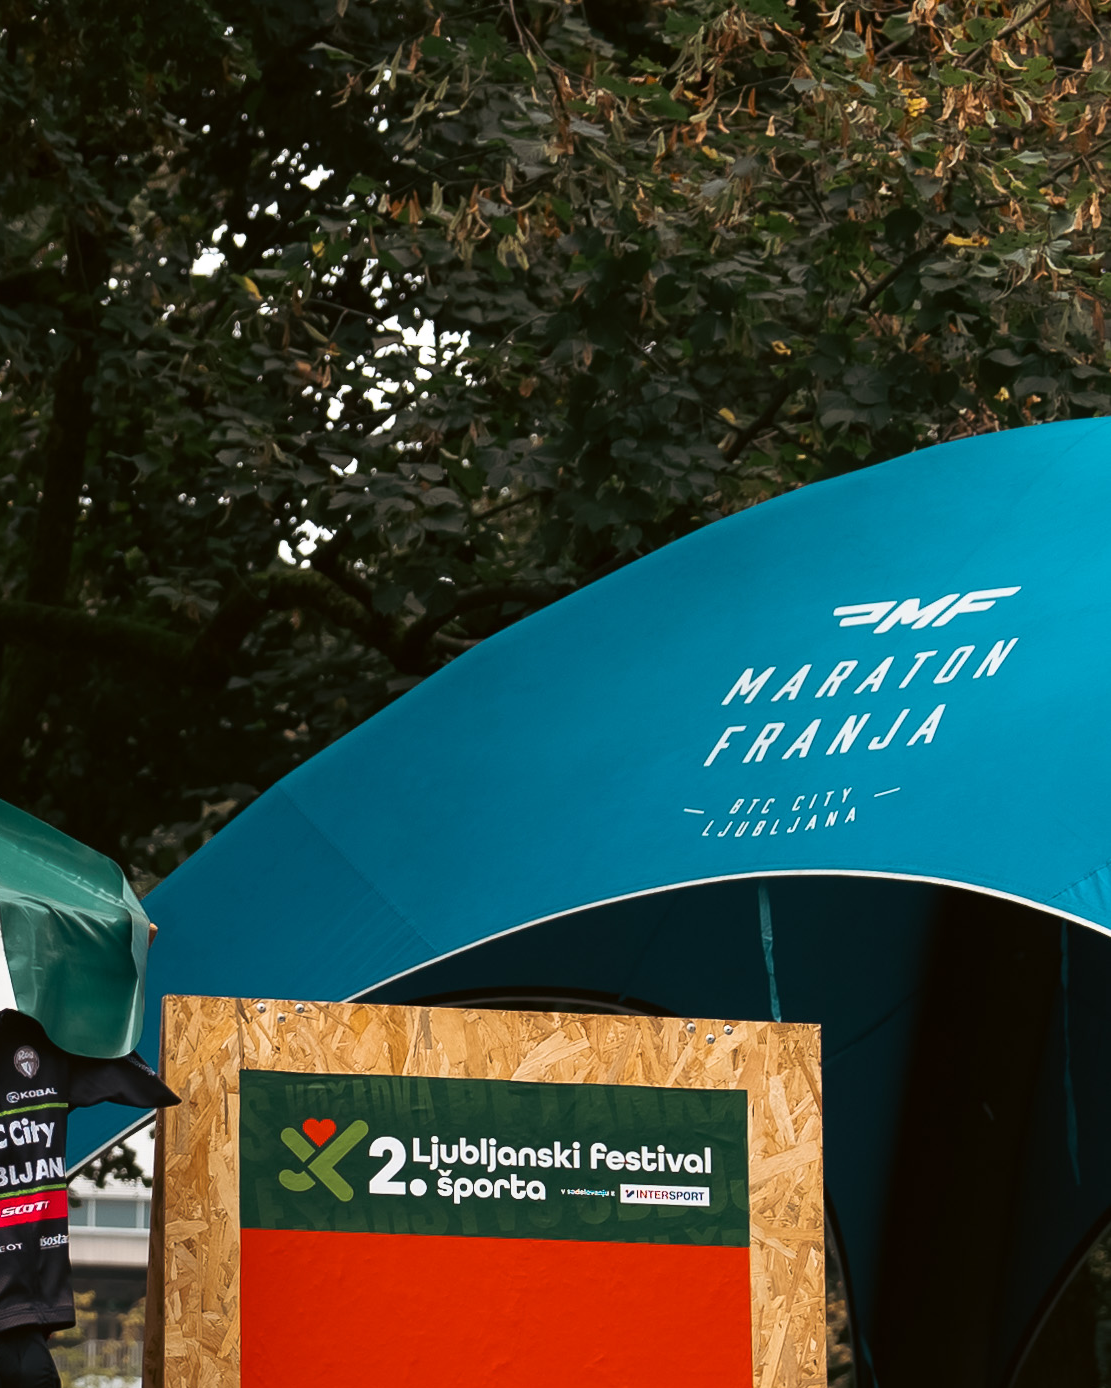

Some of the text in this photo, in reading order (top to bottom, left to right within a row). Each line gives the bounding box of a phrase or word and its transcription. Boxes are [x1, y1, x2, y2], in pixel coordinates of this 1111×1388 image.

[721, 637, 1019, 705] MARATON
[703, 704, 946, 766] FRANJA
[729, 787, 853, 815] BTC CITY
[702, 806, 857, 837] LJUBLJANA
[20, 1087, 58, 1099] KOBAL
[9, 1117, 55, 1148] City
[368, 1135, 712, 1197] 2. Ljubljanski festival
[436, 1169, 546, 1204] športa
[636, 1189, 705, 1201] INTERSPORT
[1, 1200, 50, 1217] SCOTT
